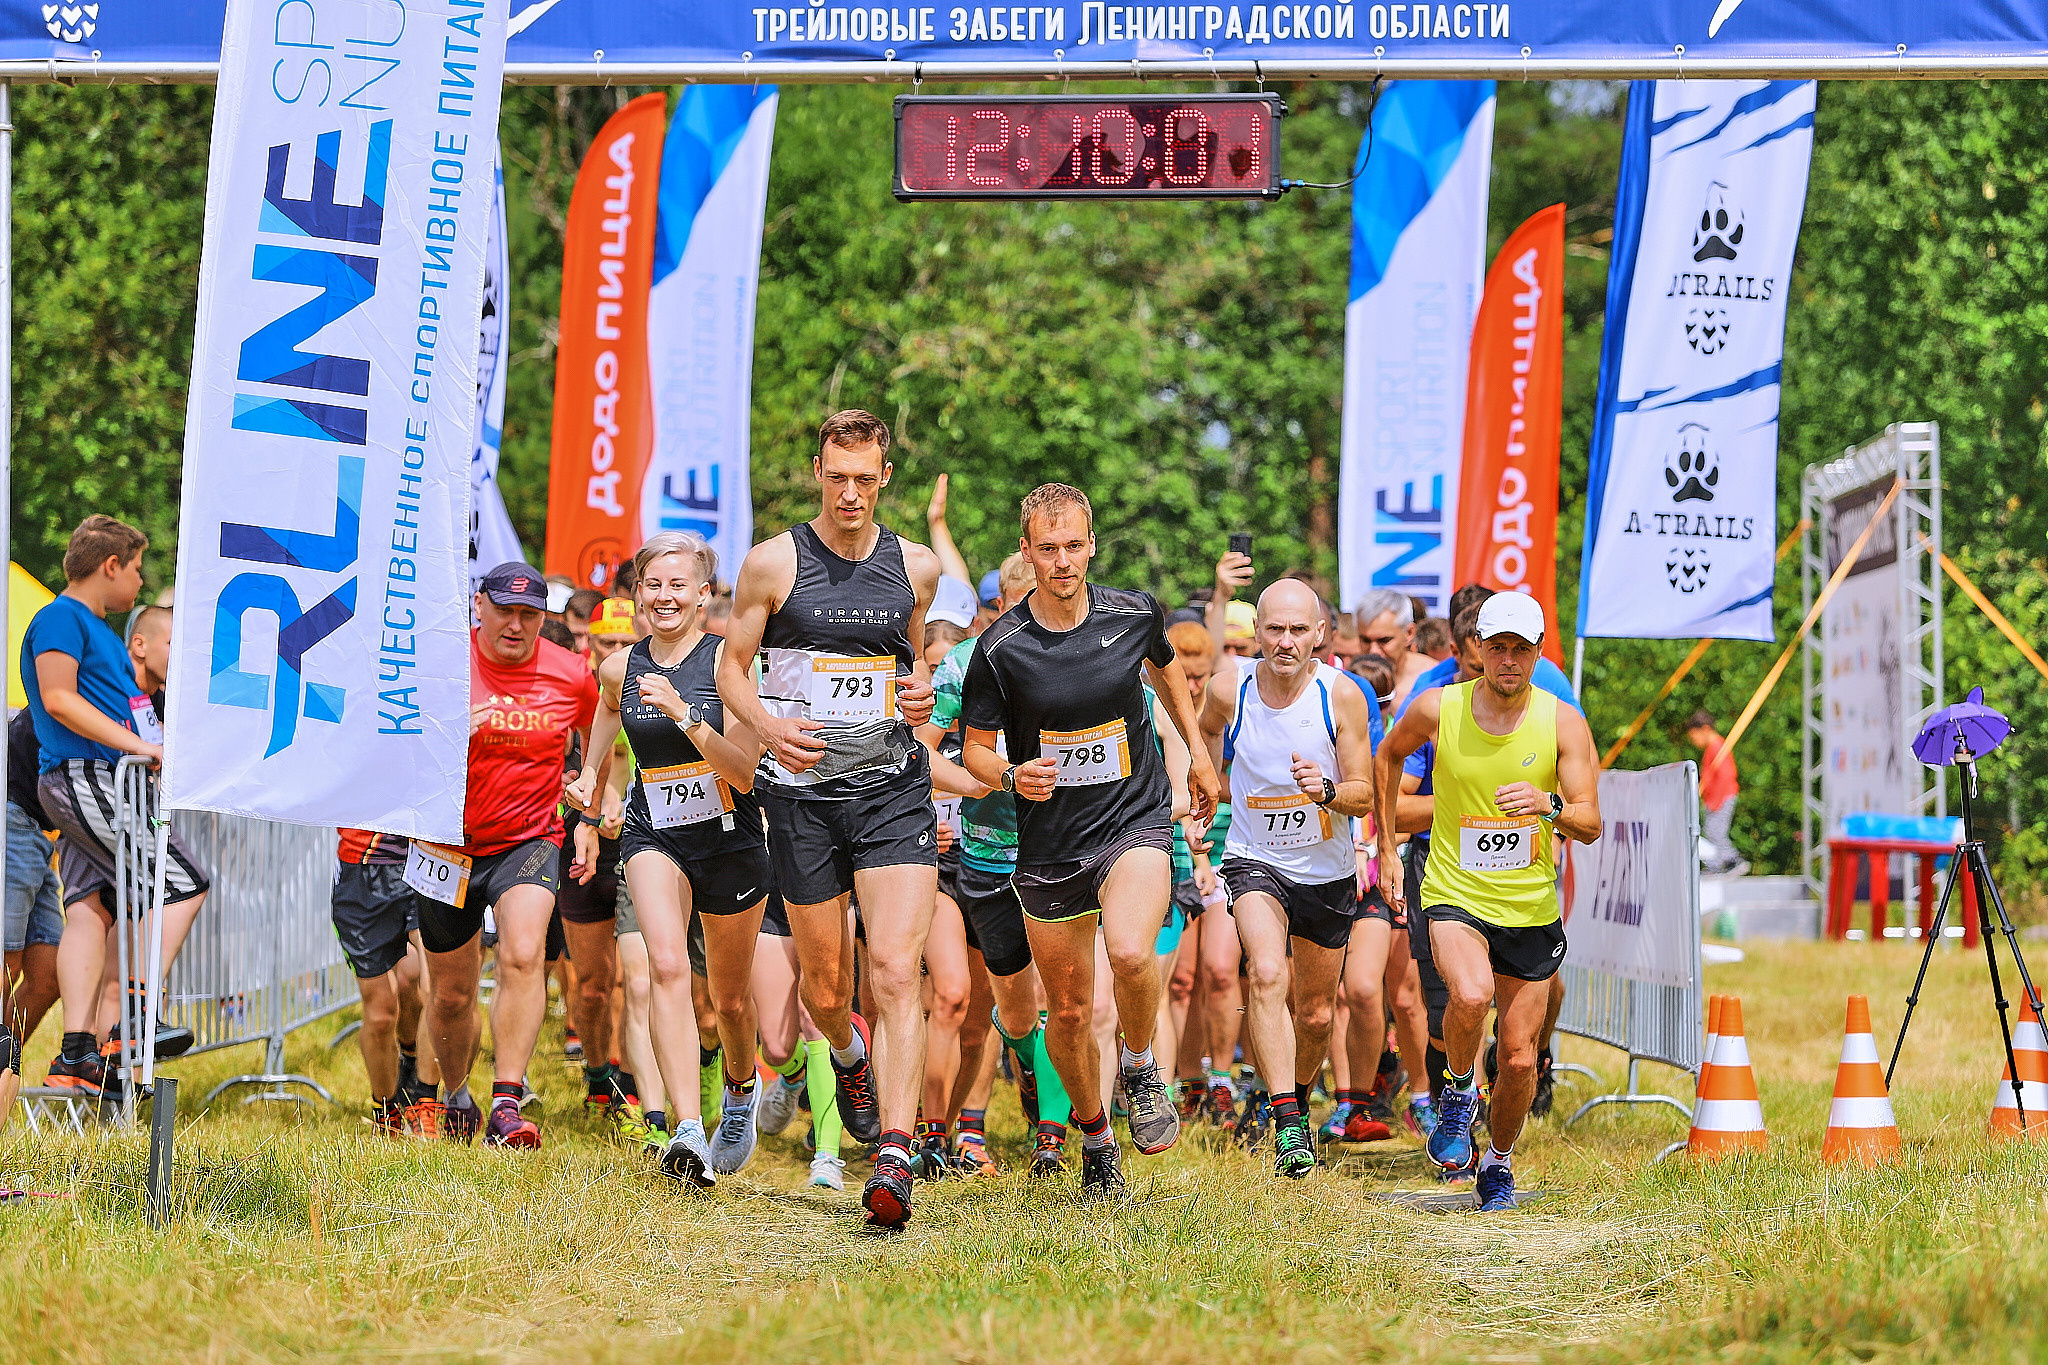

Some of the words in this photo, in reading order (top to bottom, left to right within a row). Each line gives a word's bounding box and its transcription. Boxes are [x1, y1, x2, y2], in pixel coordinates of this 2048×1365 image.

[752, 0, 936, 42] ТРЕЙЛОВЫЕ
[949, 6, 1065, 42] ЗАБЕГИ
[1368, 4, 1511, 40] ОБЛАСТИ
[437, 0, 485, 117] ПИТА
[411, 130, 469, 404] СПОРТИВНОЕ
[1413, 281, 1449, 472] NUTRITION
[1623, 511, 1756, 541] A-TRAILS
[377, 417, 427, 735] КАЧЕСТВЕННОЕ
[813, 608, 901, 619] PIRANHA
[829, 676, 873, 699] 793
[479, 709, 558, 732] BORG
[1058, 744, 1107, 768] 798
[660, 780, 706, 806] 794
[1263, 810, 1307, 831] 779
[1476, 832, 1521, 853] 699
[417, 853, 450, 882] 710
